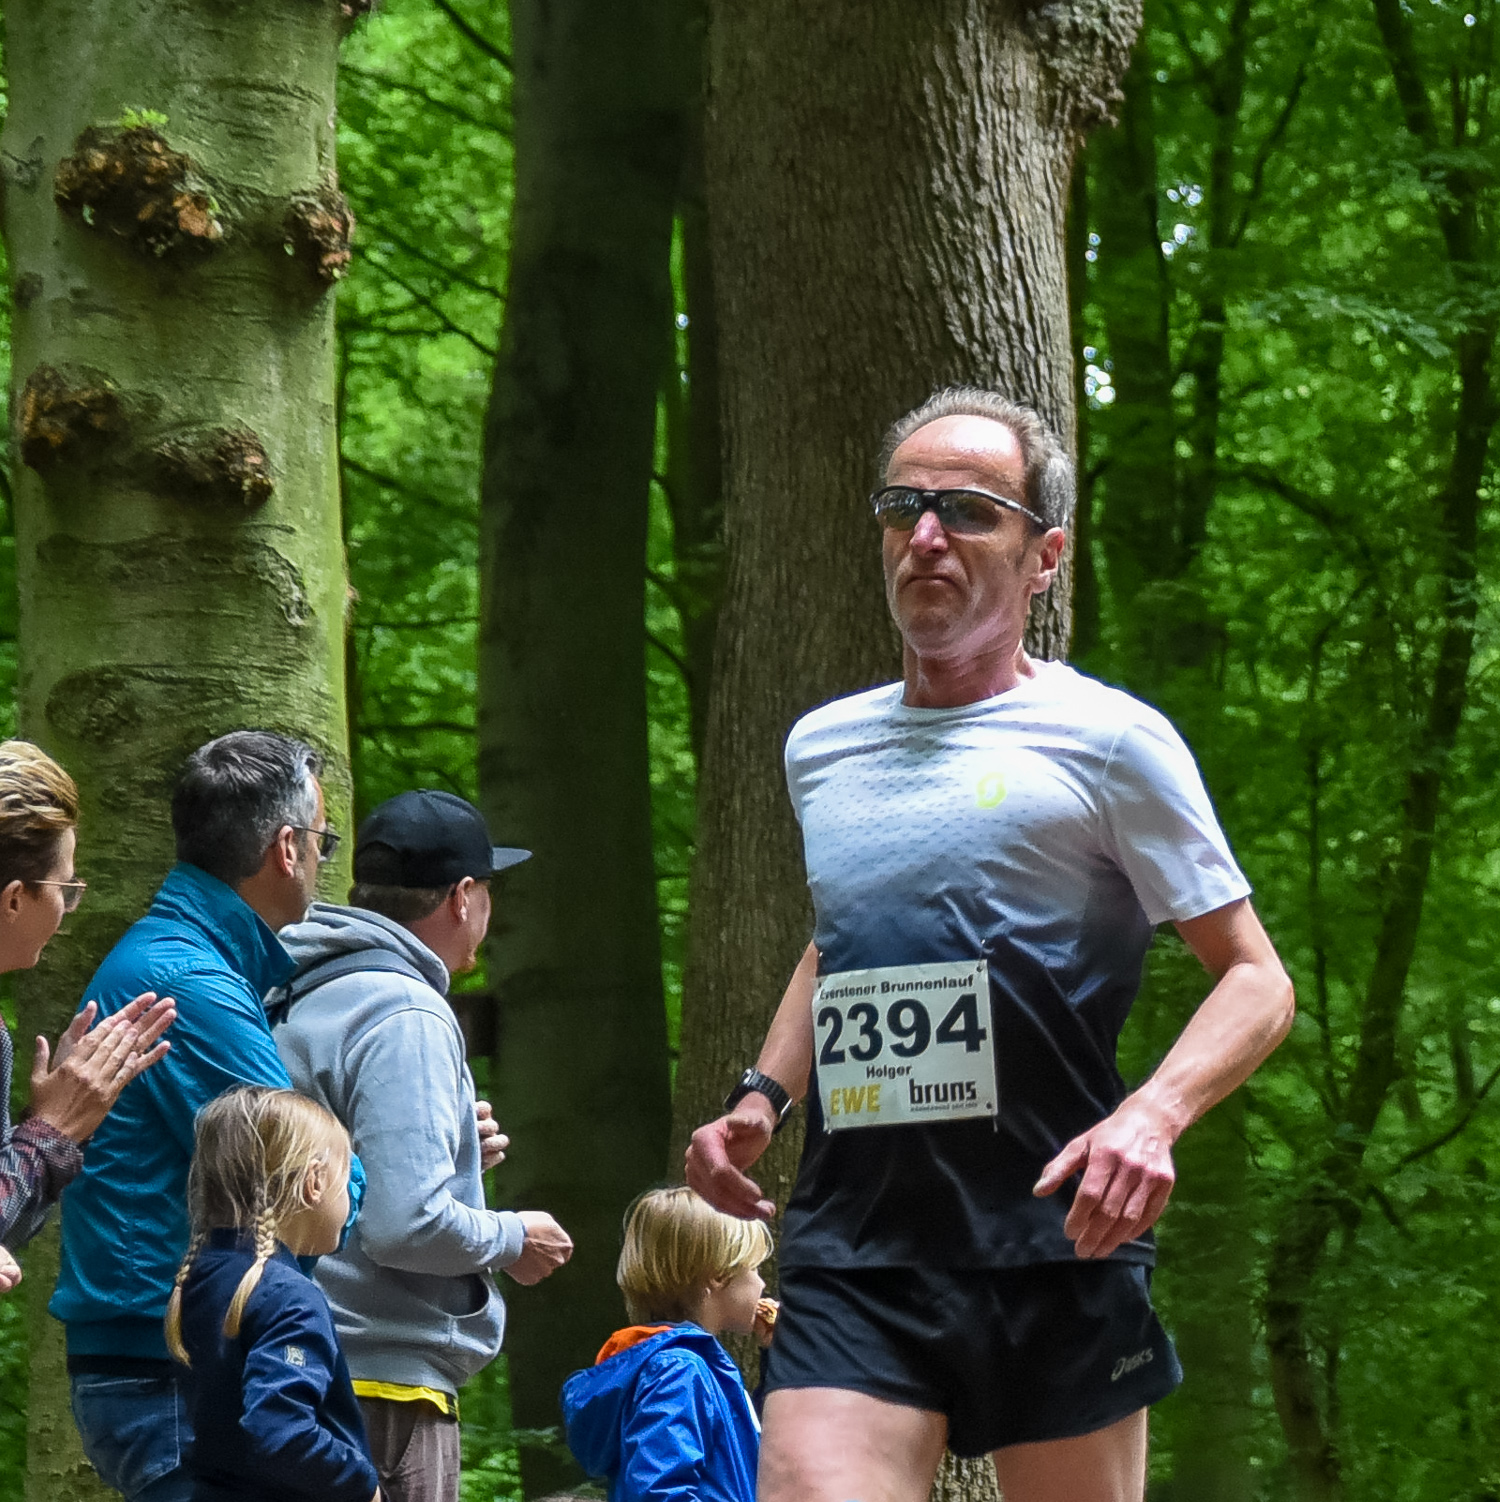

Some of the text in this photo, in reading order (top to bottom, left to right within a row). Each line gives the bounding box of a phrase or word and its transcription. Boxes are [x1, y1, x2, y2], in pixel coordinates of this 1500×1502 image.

[881, 974, 974, 994] Brunnenlauf
[817, 993, 987, 1066] 2394
[866, 1065, 912, 1080] Holger
[830, 1084, 882, 1115] EWE
[909, 1078, 977, 1105] bruns
